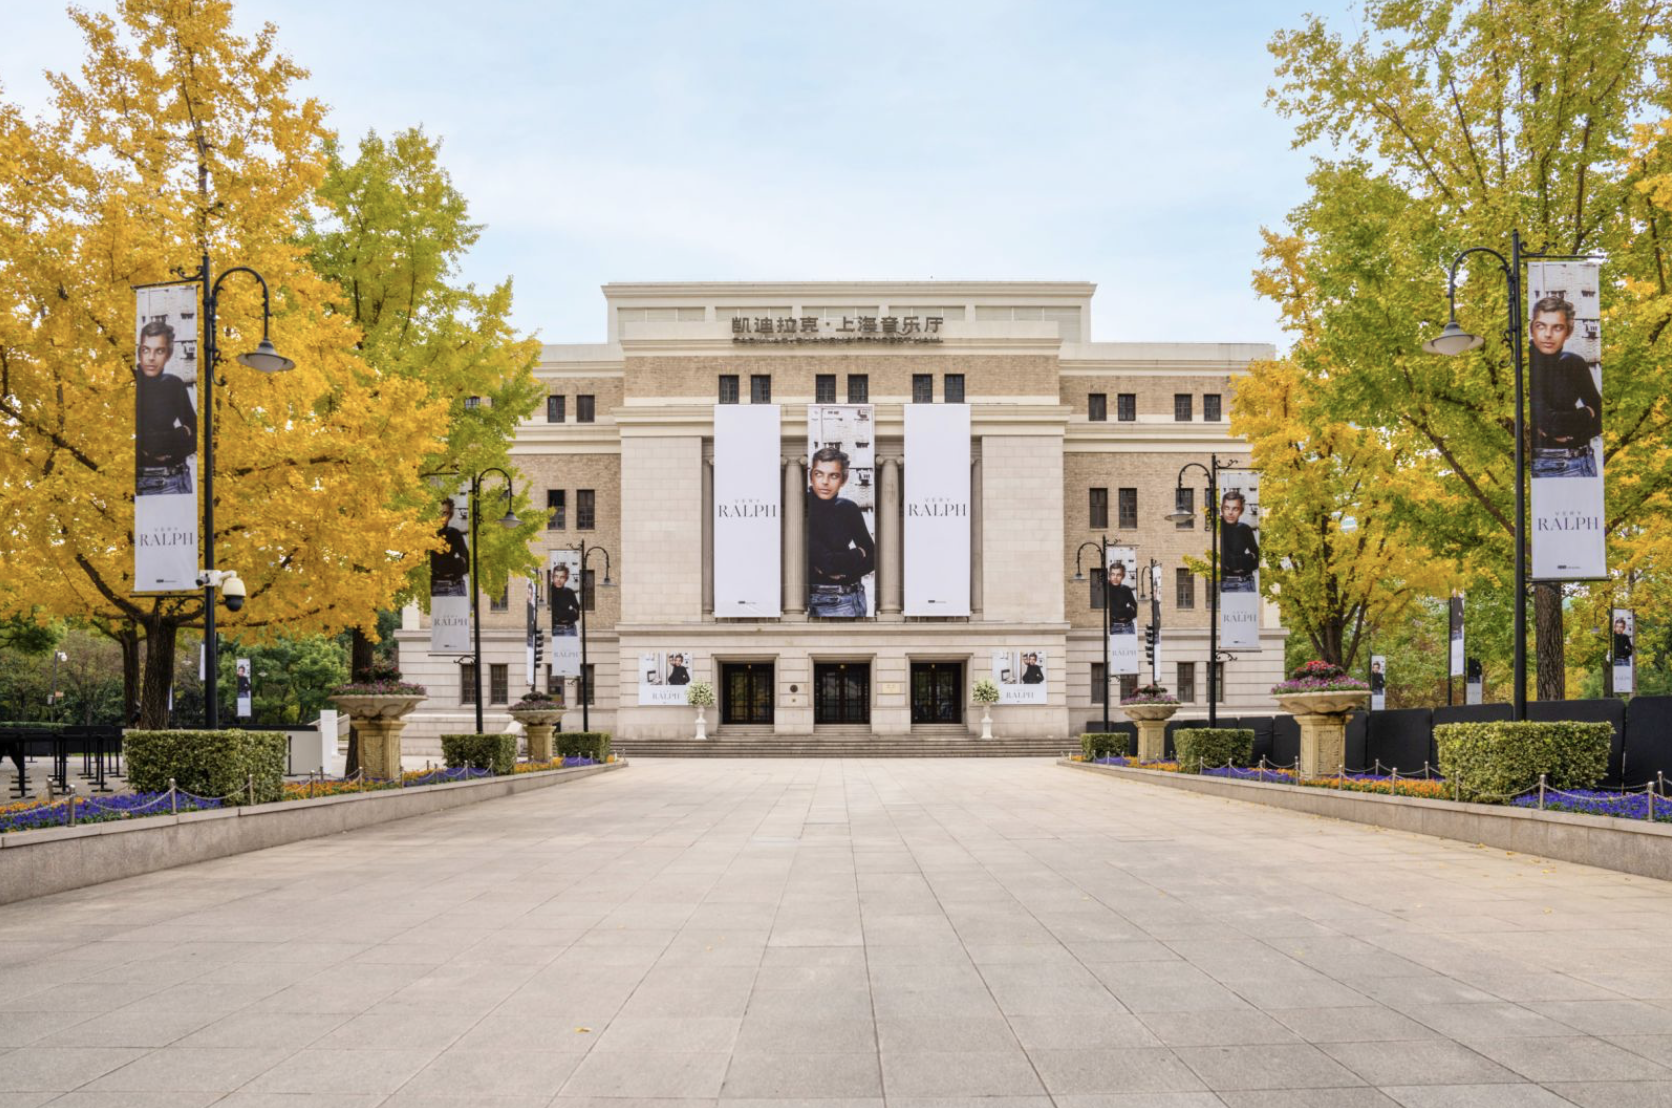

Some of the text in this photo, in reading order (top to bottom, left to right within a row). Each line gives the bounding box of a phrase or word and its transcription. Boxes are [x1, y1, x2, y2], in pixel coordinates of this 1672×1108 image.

[718, 504, 776, 518] RALPH
[908, 503, 966, 517] RALPH
[1538, 517, 1598, 531] RALPH
[140, 532, 193, 546] RALPH
